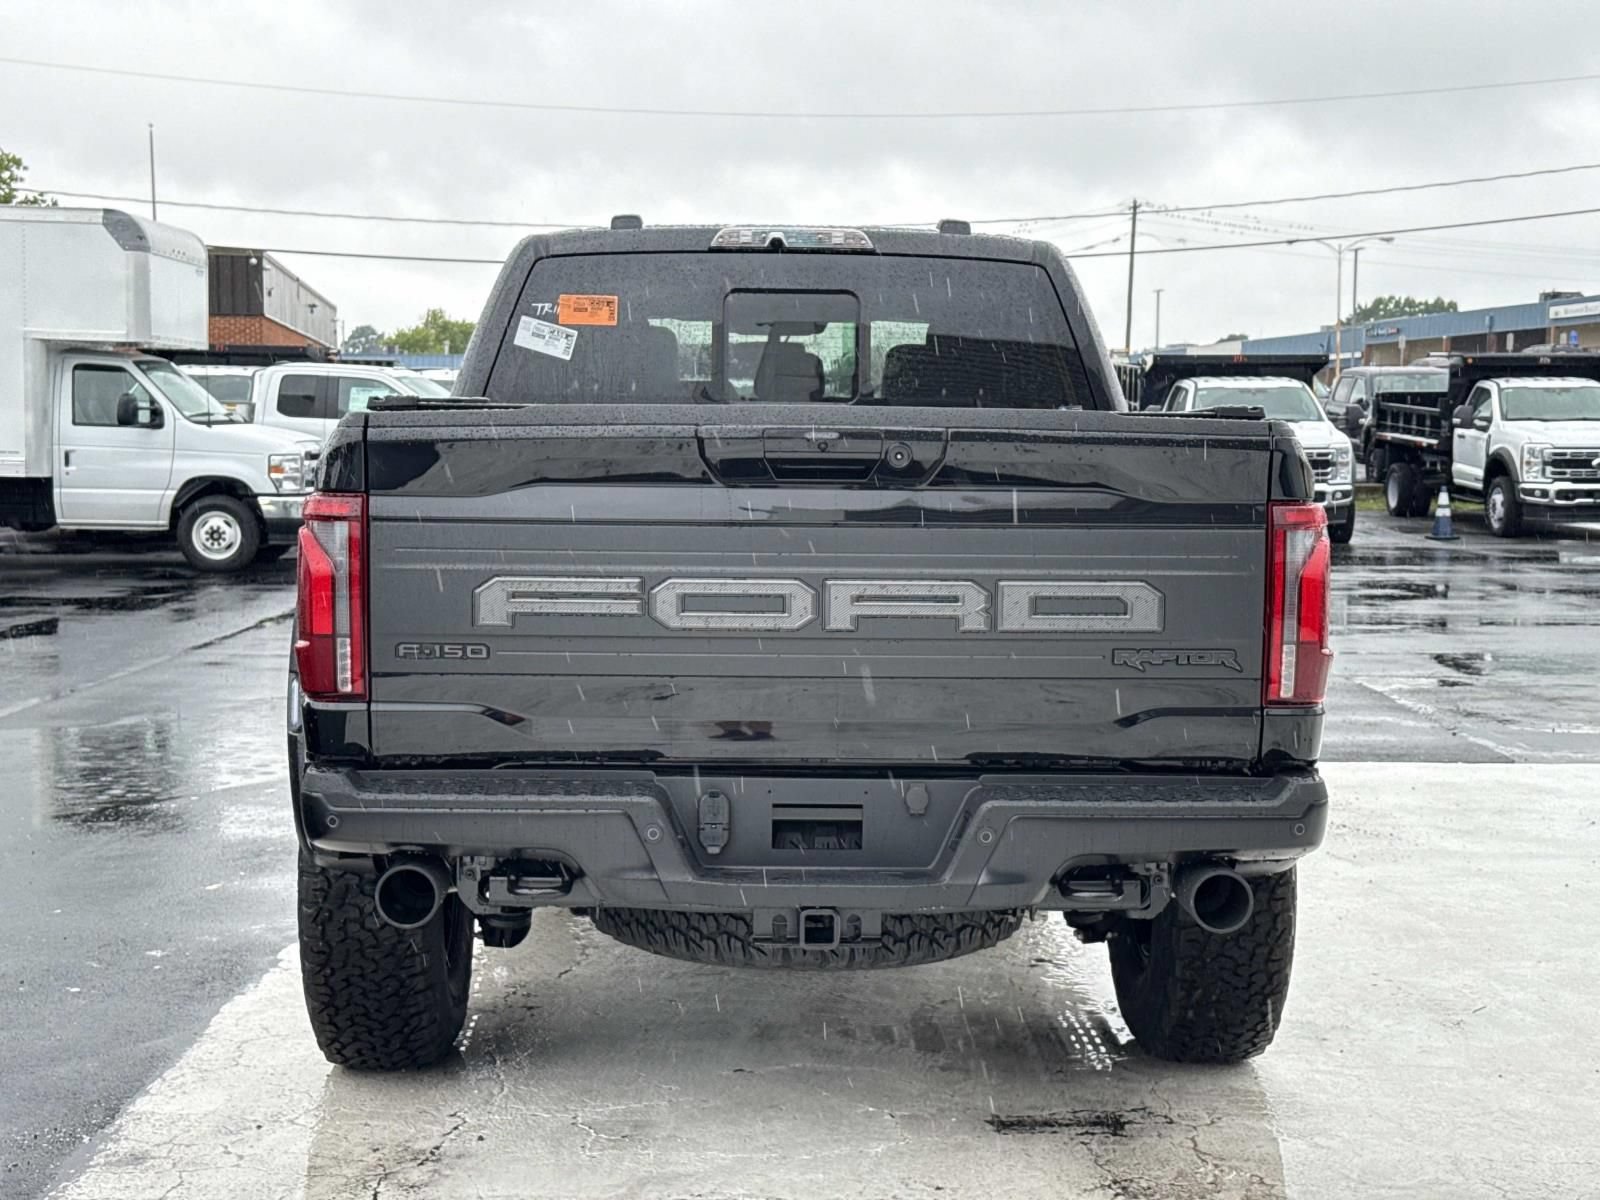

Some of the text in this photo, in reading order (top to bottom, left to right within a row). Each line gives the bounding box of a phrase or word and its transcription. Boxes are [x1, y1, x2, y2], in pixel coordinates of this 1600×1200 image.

[473, 576, 1165, 632] FORD
[397, 643, 489, 659] F-150
[1113, 649, 1242, 672] RAPTOR
